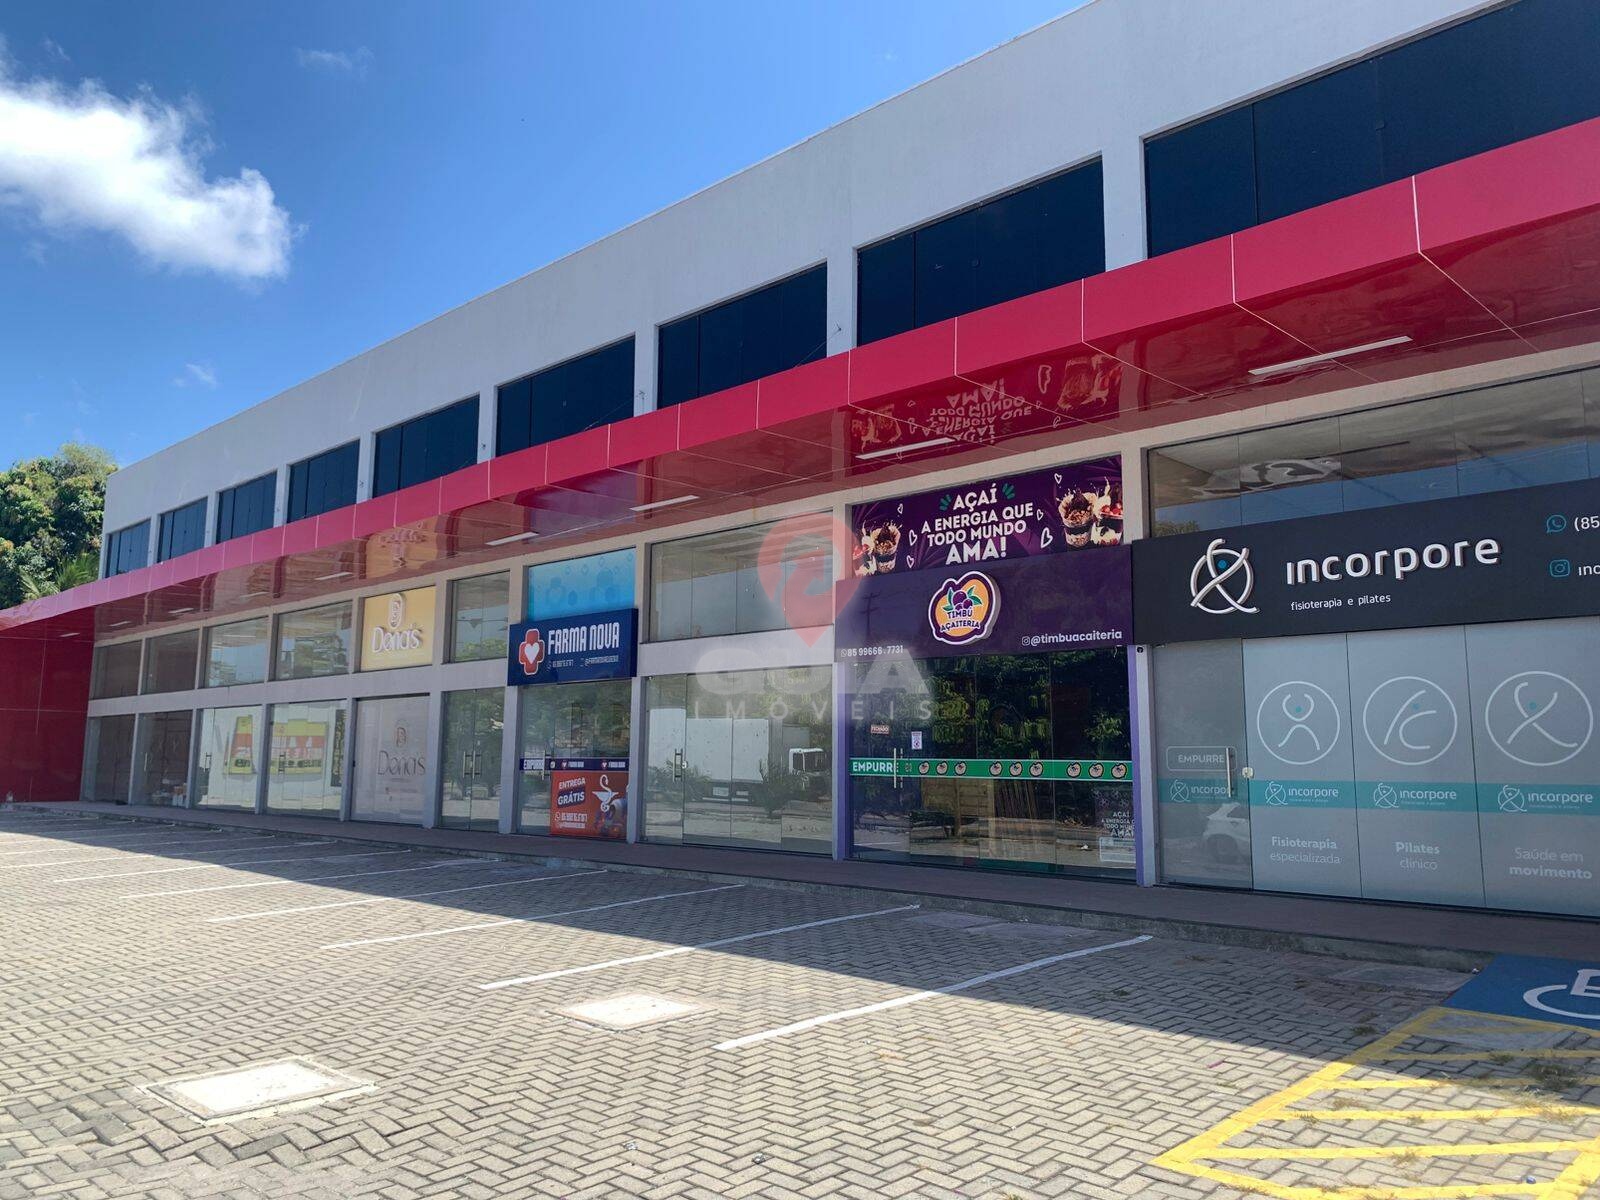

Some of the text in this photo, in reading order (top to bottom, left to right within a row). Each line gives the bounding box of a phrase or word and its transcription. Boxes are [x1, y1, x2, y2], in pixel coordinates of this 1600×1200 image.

[953, 483, 998, 512] AÇAÍ
[921, 502, 1034, 534] A ENERGIA QUE
[927, 521, 1027, 547] TODO MUNDO
[945, 536, 1007, 565] AMA!
[1286, 536, 1502, 585] incorpore
[1291, 594, 1391, 611] fisioterapia e pilates
[548, 622, 620, 655] FARMA NOVA
[1031, 629, 1123, 647] @timbuacaiteria
[847, 645, 903, 657] 85 99666.7731
[1178, 754, 1225, 764] EMPURRE
[559, 777, 586, 790] ENTREGA
[557, 791, 585, 805] GRÁTIS
[1288, 788, 1339, 798] incorpore
[1400, 789, 1458, 801] incorpore
[1528, 791, 1593, 804] incorpore
[1271, 836, 1337, 850] Fisioterapia
[1395, 841, 1440, 854] Pilates
[1270, 853, 1341, 865] especializada
[1514, 847, 1584, 863] Saúde em
[1509, 865, 1593, 880] movimento
